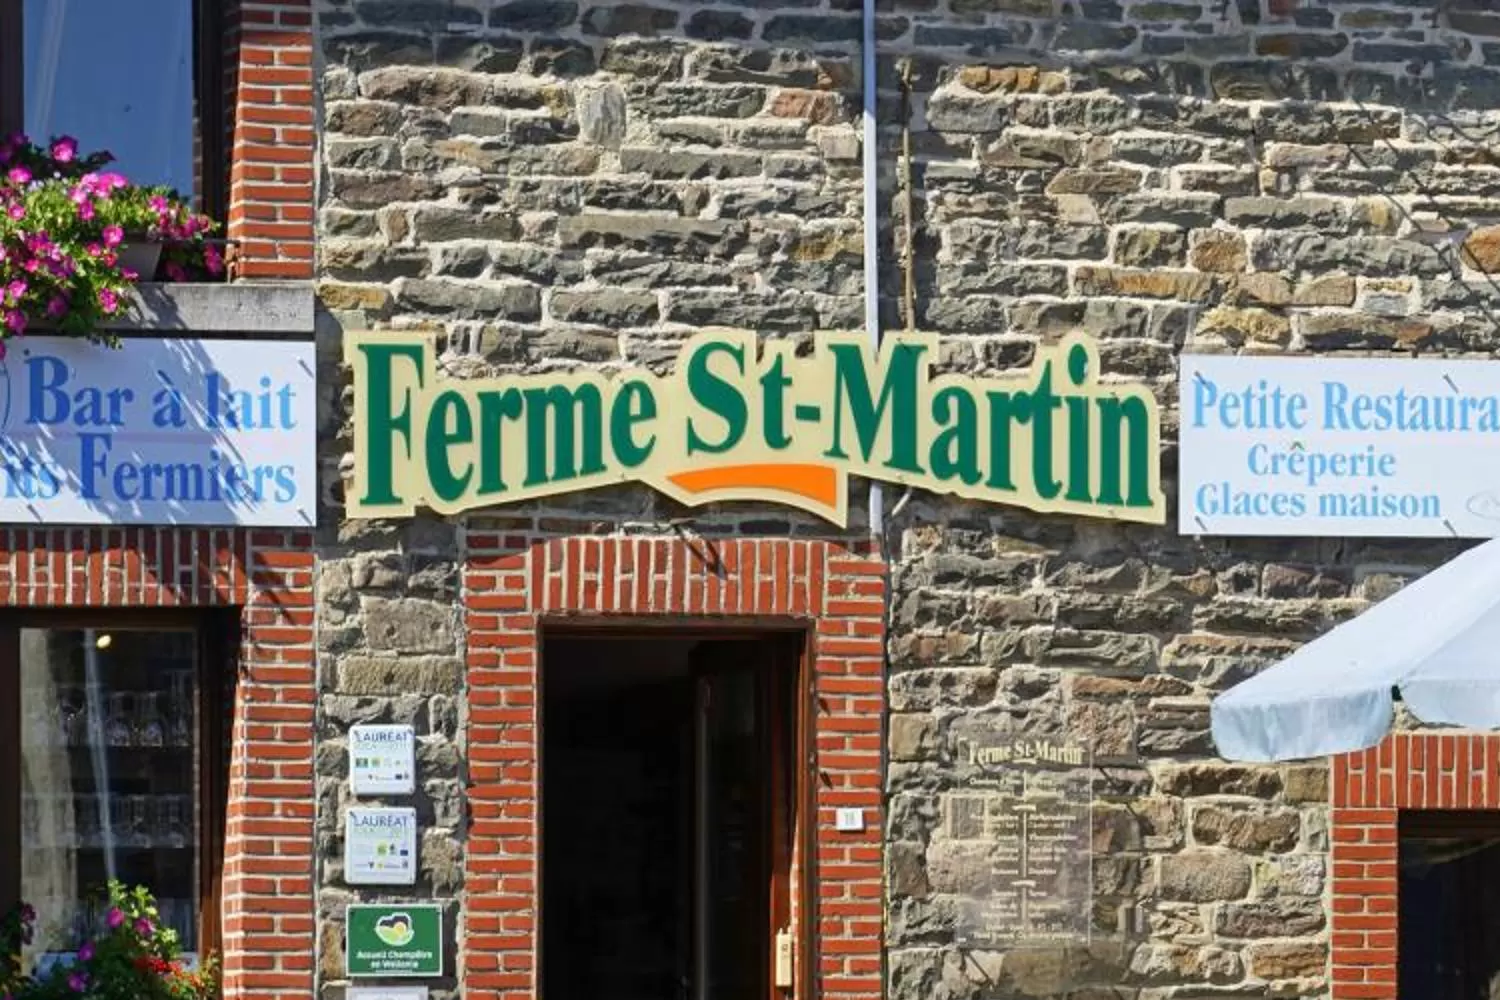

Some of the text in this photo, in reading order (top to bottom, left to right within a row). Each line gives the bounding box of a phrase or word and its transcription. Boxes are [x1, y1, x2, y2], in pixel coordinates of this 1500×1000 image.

[23, 355, 298, 430] Bar à lait
[1191, 378, 1307, 431] Petite
[357, 341, 1154, 508] Ferme St-Martin
[77, 432, 298, 504] Fermiers
[1247, 441, 1397, 486] Crêperie
[1196, 485, 1442, 519] Glaces maison
[968, 741, 1012, 765] Ferme
